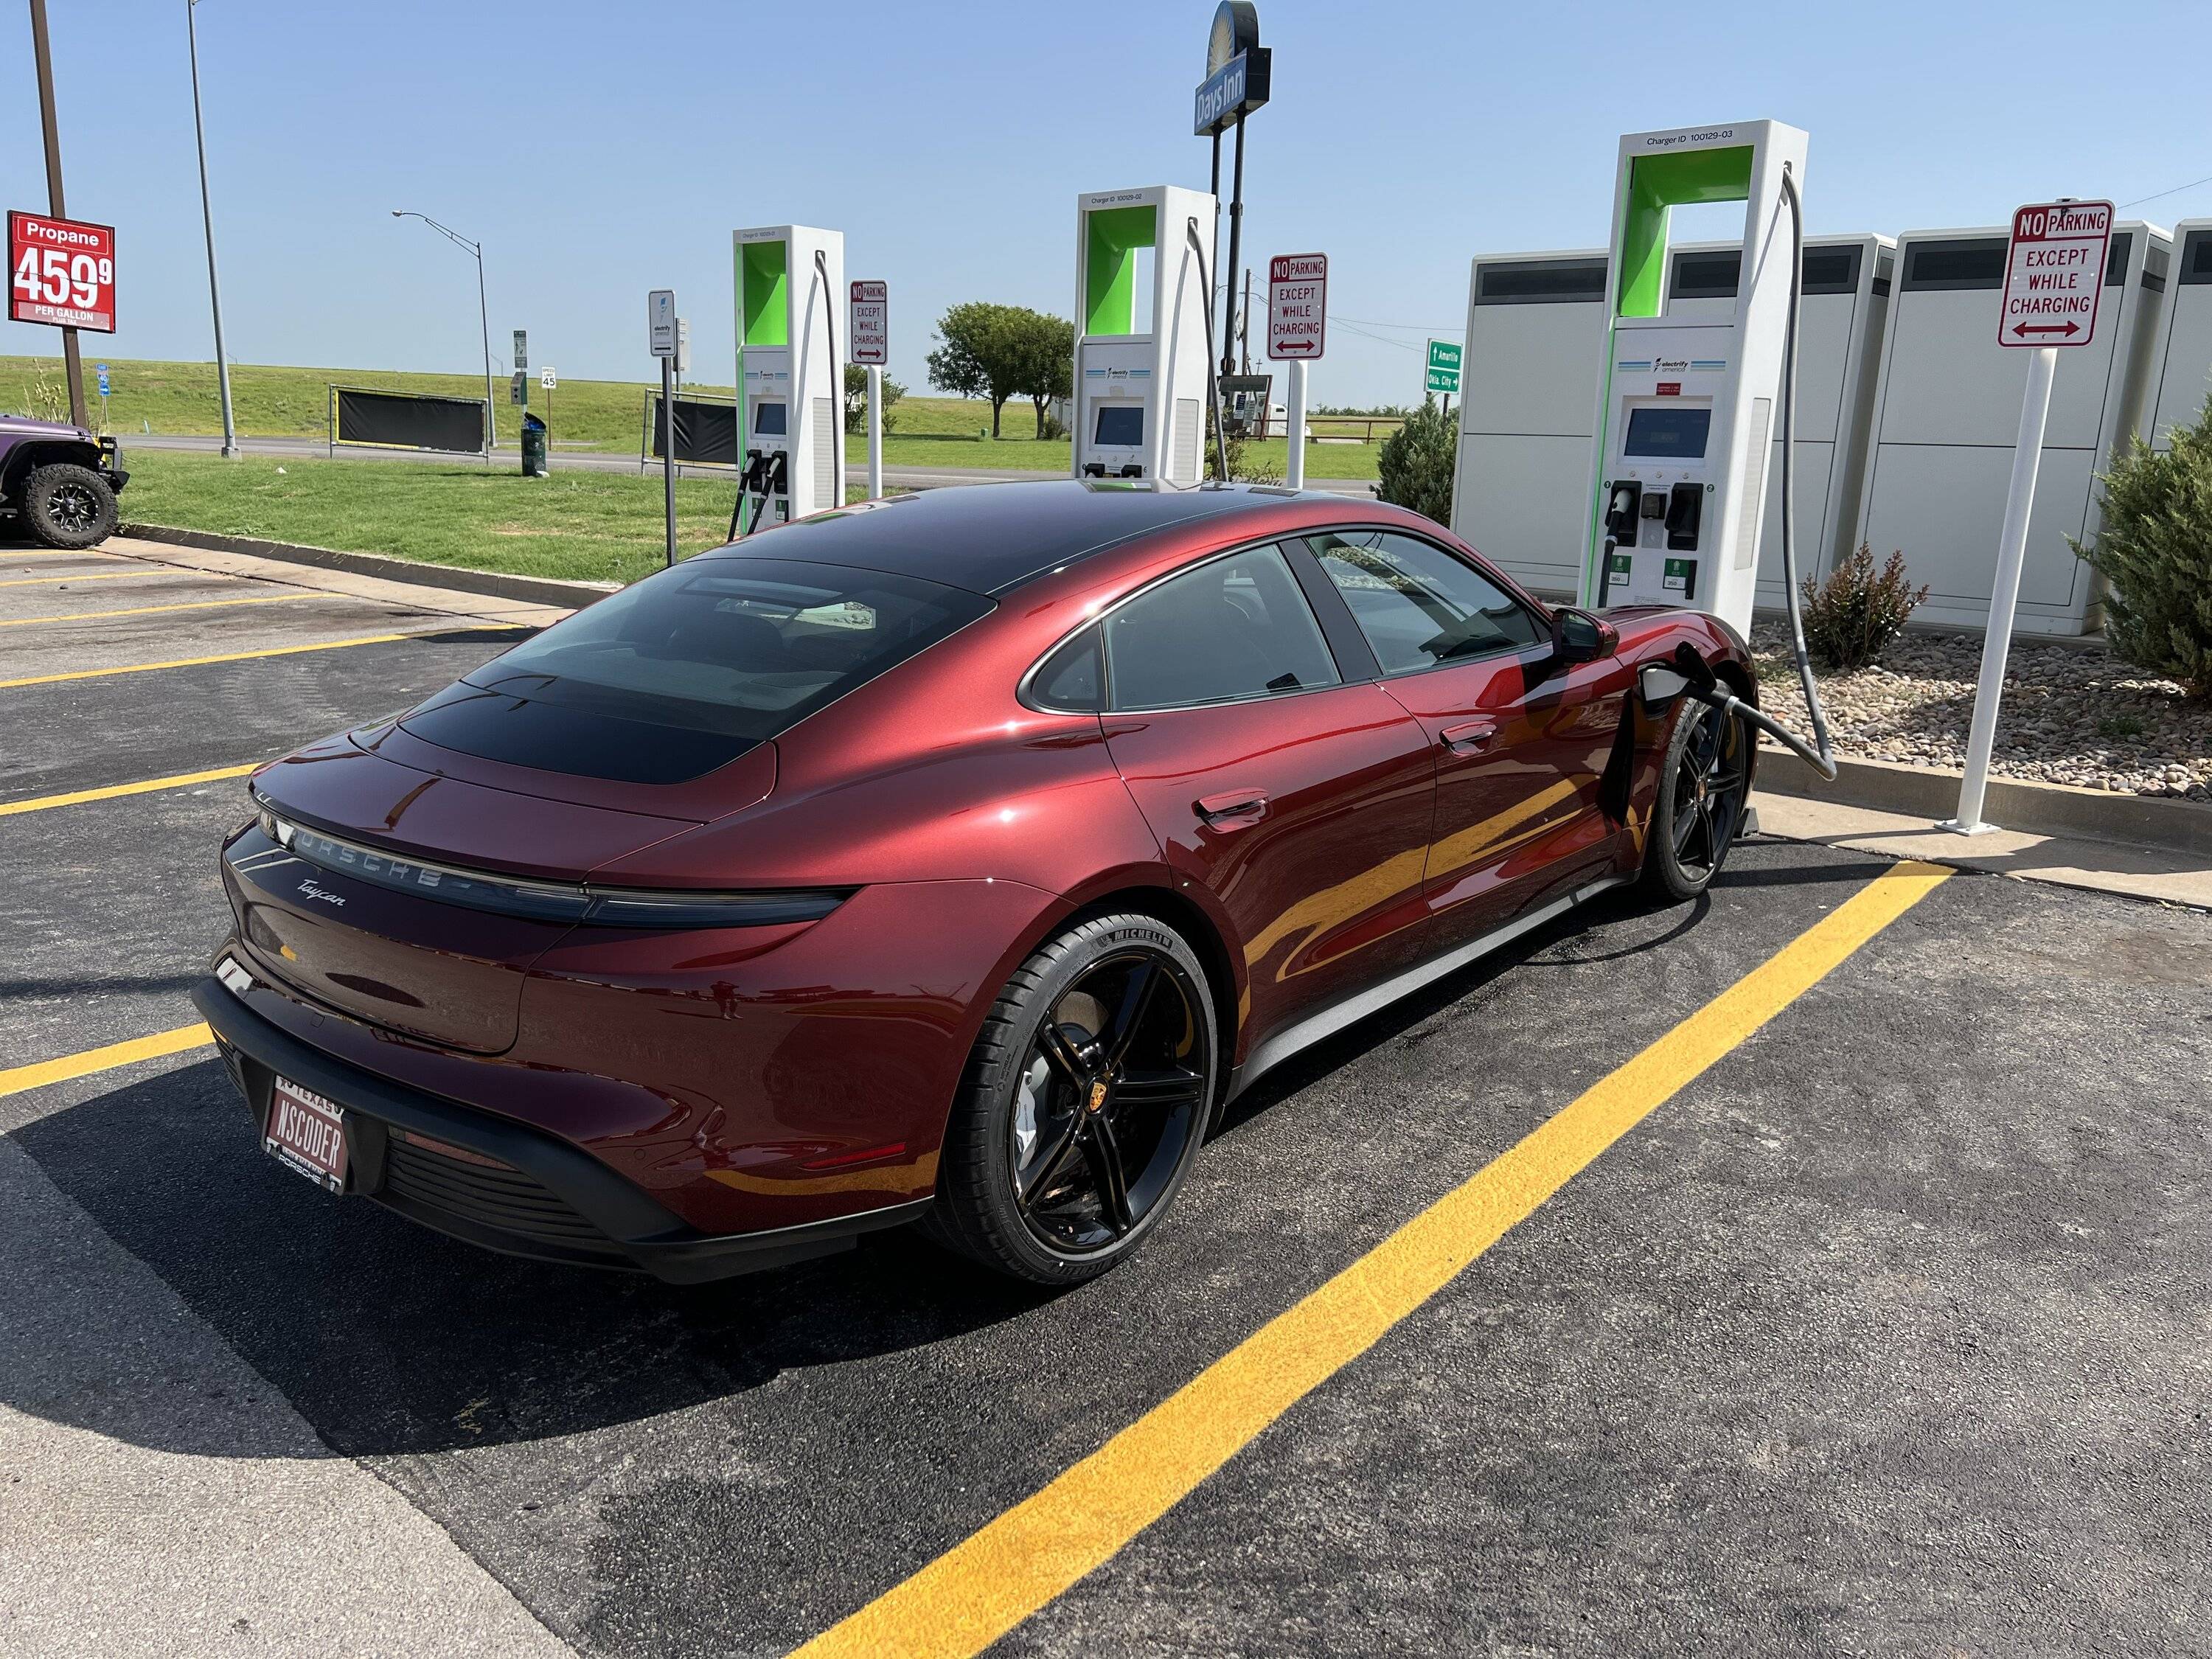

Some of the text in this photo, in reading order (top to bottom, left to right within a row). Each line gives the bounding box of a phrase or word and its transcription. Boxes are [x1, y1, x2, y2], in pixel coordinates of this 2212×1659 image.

[1197, 69, 1242, 125] Days Inn
[1647, 130, 1733, 146] Charger ID 100129-03
[2019, 212, 2106, 237] NO PARKING
[27, 221, 100, 246] Propane
[2026, 248, 2089, 267] EXCEPT
[1274, 261, 1323, 278] NO PARKING
[2029, 273, 2079, 291] WHILE
[852, 285, 885, 299] NO PARKING
[1279, 287, 1315, 301] EXCEPT
[35, 305, 94, 321] PER GALLON
[857, 307, 880, 317] EXCEPT
[1282, 305, 1311, 318] WHILE
[2010, 296, 2090, 314] CHARGING
[859, 321, 878, 331] WHILE
[1273, 322, 1319, 335] CHARGING
[854, 335, 884, 345] CHARGING
[1438, 349, 1458, 363] Amarillo
[543, 378, 555, 386] 45
[1428, 374, 1452, 389] Okla. City
[296, 878, 347, 907] Taycan
[1114, 928, 1171, 949] MICHELIN
[276, 1099, 341, 1169] NSCODER
[278, 1154, 321, 1185] PORSCHE
